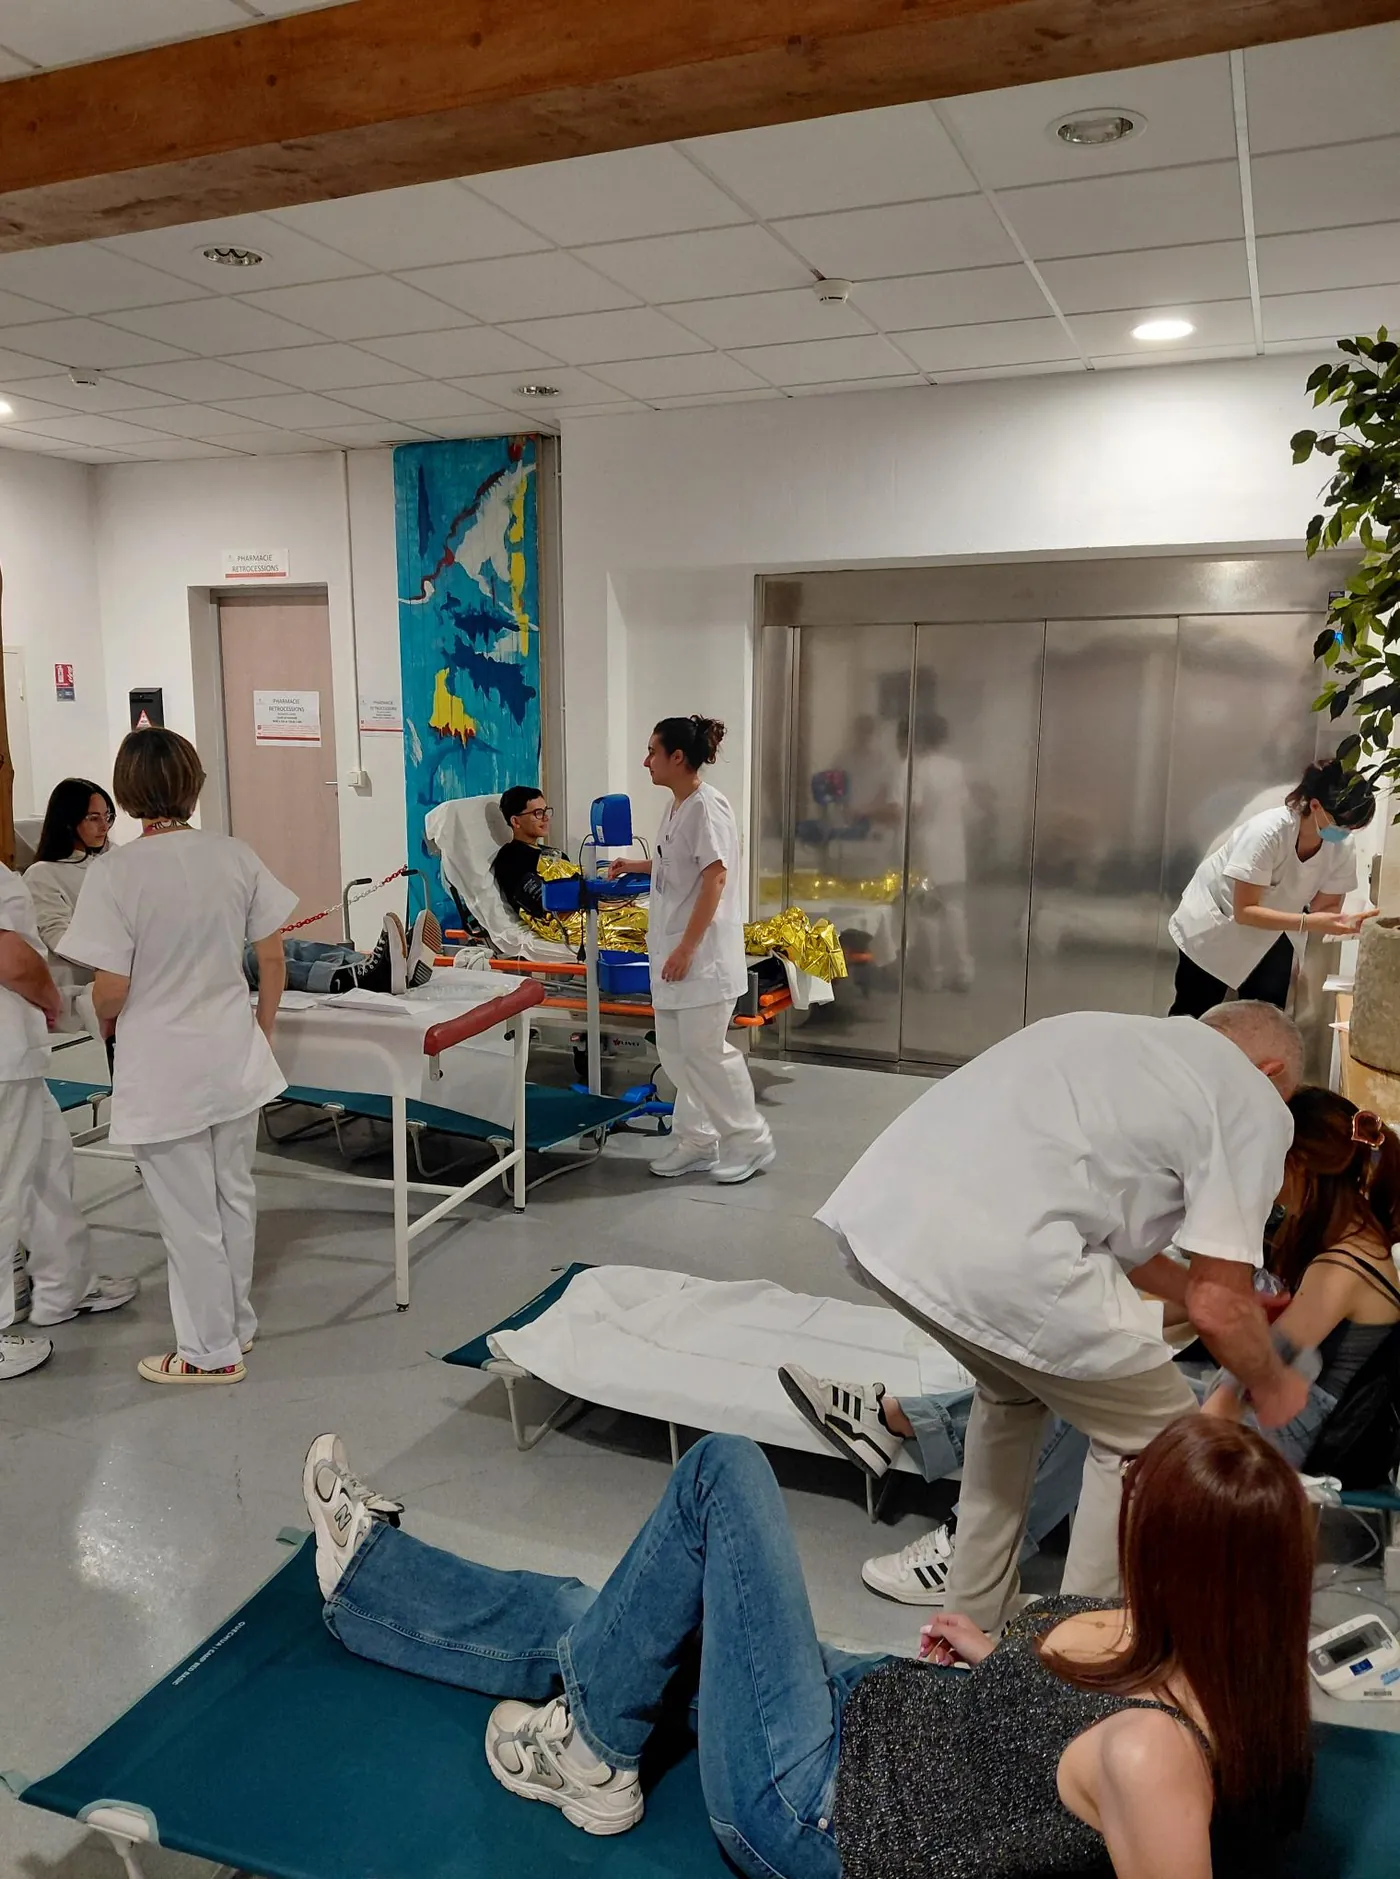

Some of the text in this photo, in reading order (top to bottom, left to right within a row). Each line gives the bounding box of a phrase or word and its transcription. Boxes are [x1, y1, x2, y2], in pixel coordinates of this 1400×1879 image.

[237, 554, 273, 562] PHARMACIE
[232, 564, 279, 572] RETROCESSIONS
[215, 1621, 246, 1647] QUECHUA
